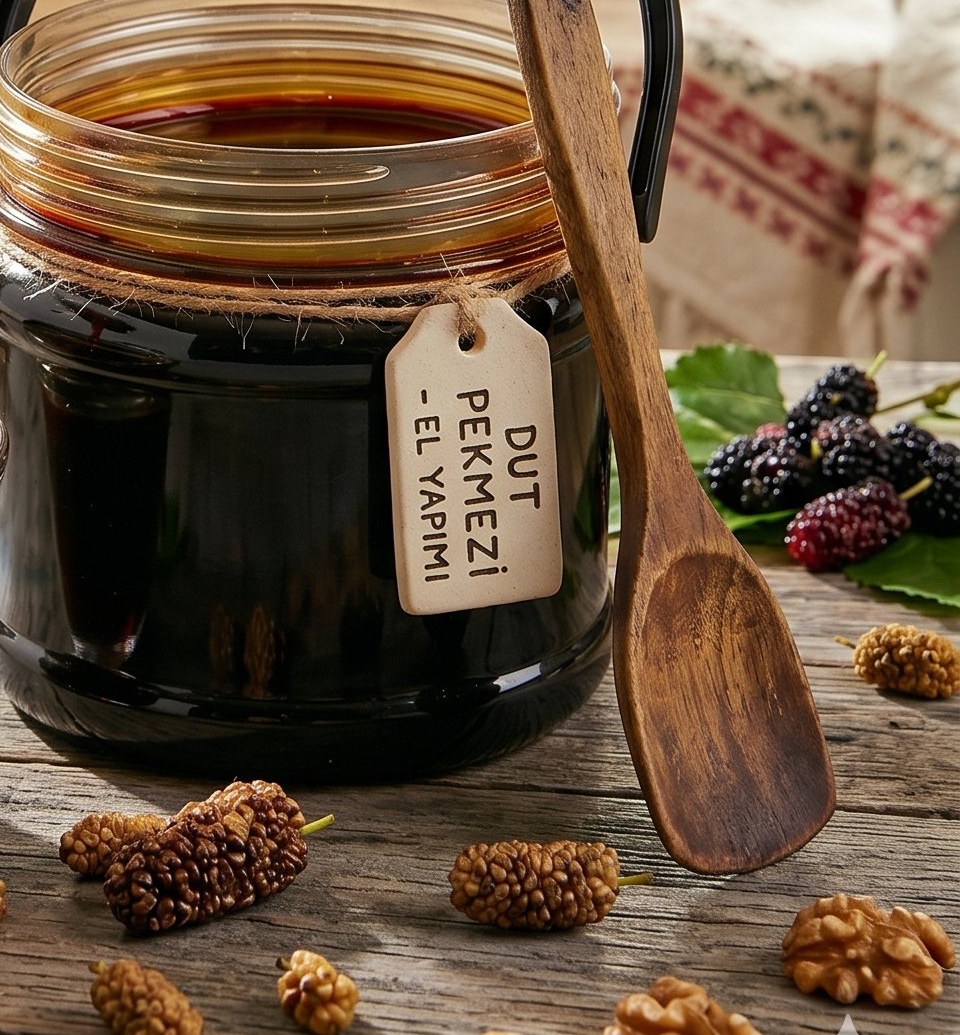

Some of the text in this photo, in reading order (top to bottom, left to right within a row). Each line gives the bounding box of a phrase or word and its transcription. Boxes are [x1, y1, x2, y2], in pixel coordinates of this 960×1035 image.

[419, 466, 450, 582] YAPIMI
[456, 389, 508, 577] PEKMEZİ
[504, 424, 540, 509] DUT
